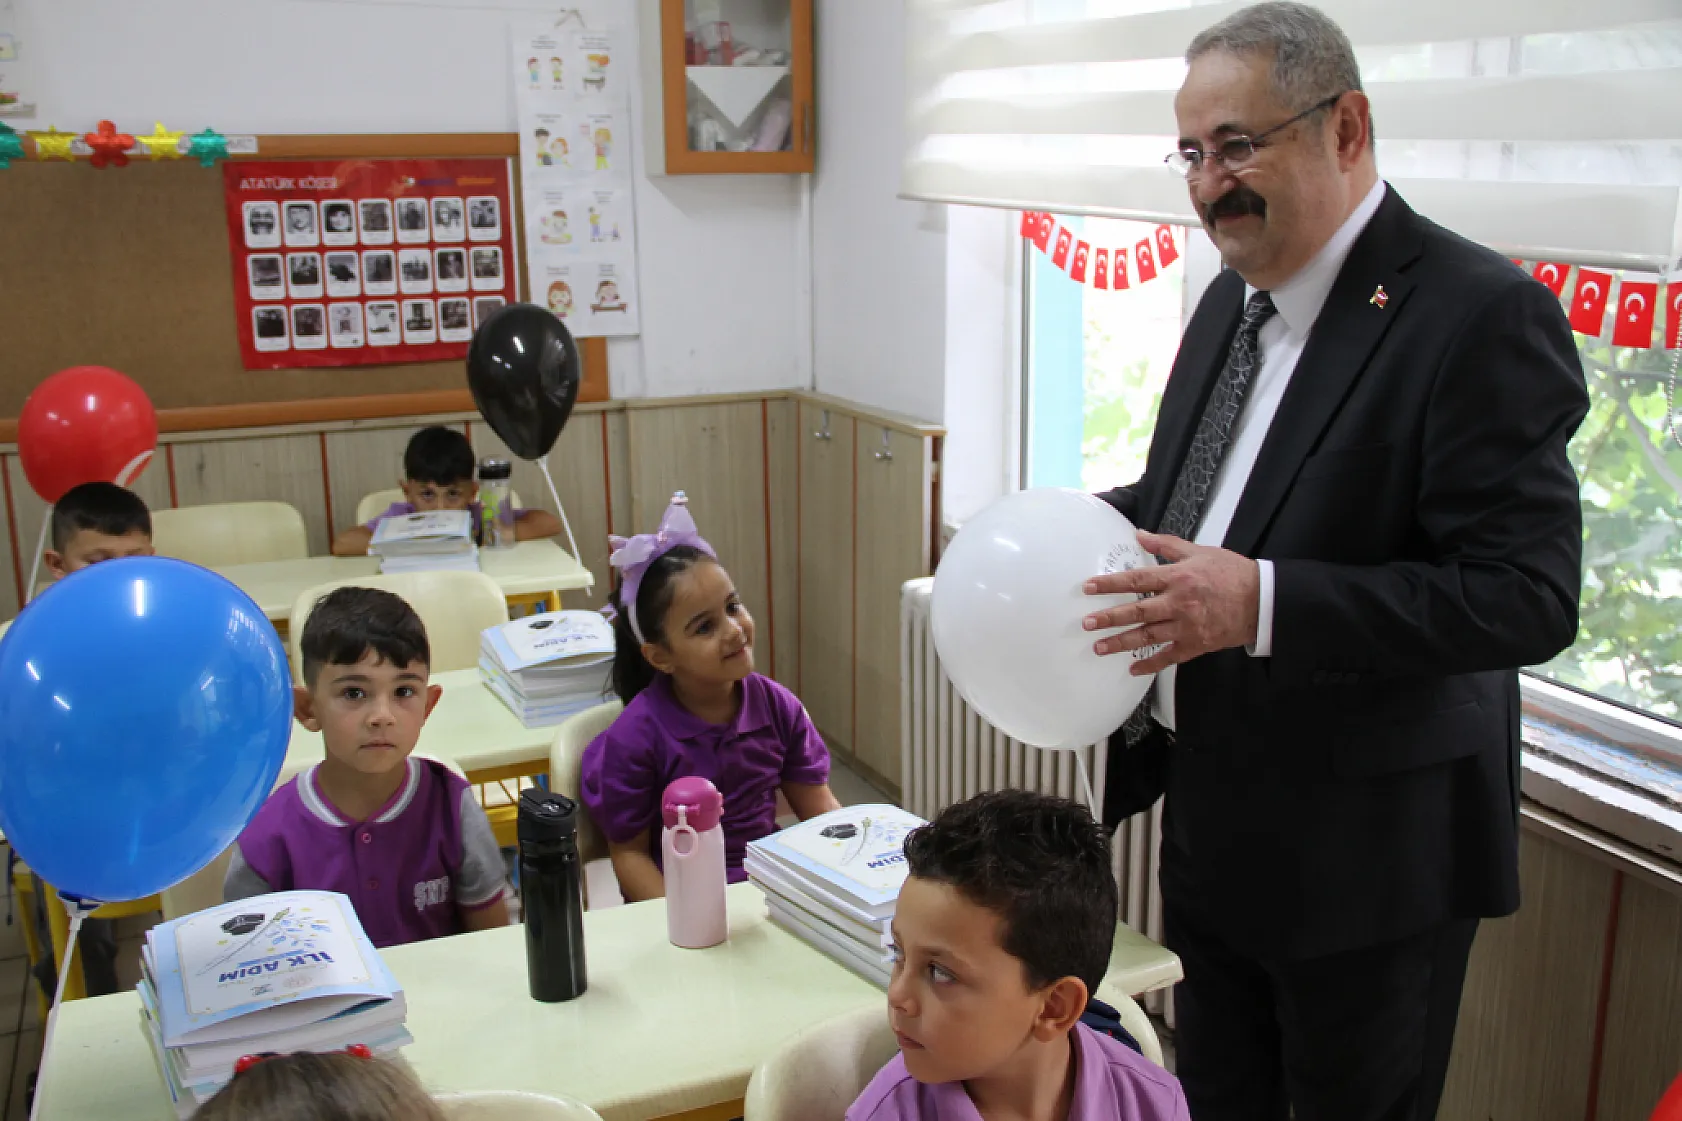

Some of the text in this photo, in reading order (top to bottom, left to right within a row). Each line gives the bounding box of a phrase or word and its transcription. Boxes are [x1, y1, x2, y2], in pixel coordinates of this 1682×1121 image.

[240, 177, 296, 189] ATATÜRK
[286, 951, 335, 967] İLK
[218, 960, 279, 983] ADIM
